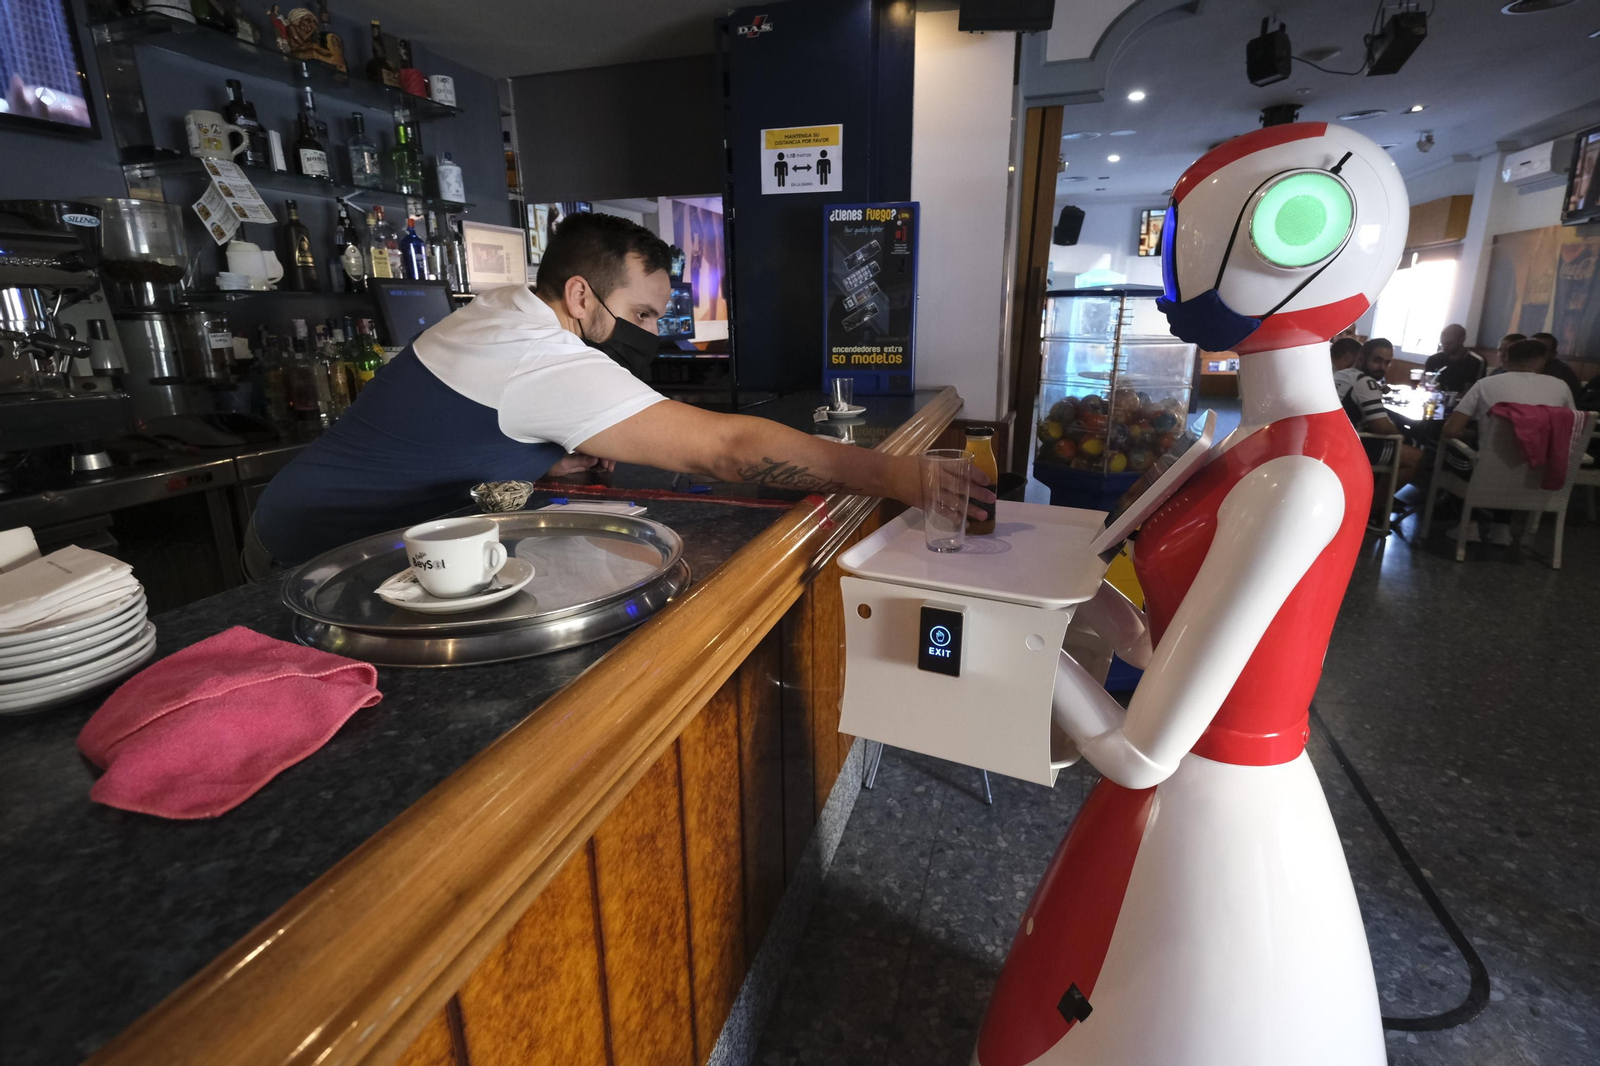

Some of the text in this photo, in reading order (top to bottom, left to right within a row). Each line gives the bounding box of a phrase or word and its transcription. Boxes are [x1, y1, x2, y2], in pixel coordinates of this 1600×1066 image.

[738, 23, 771, 35] DAS
[436, 76, 450, 84] NOT
[865, 208, 897, 223] fuego?
[882, 345, 904, 353] extra
[831, 353, 903, 364] 50 modelos
[928, 646, 952, 658] EXIT
